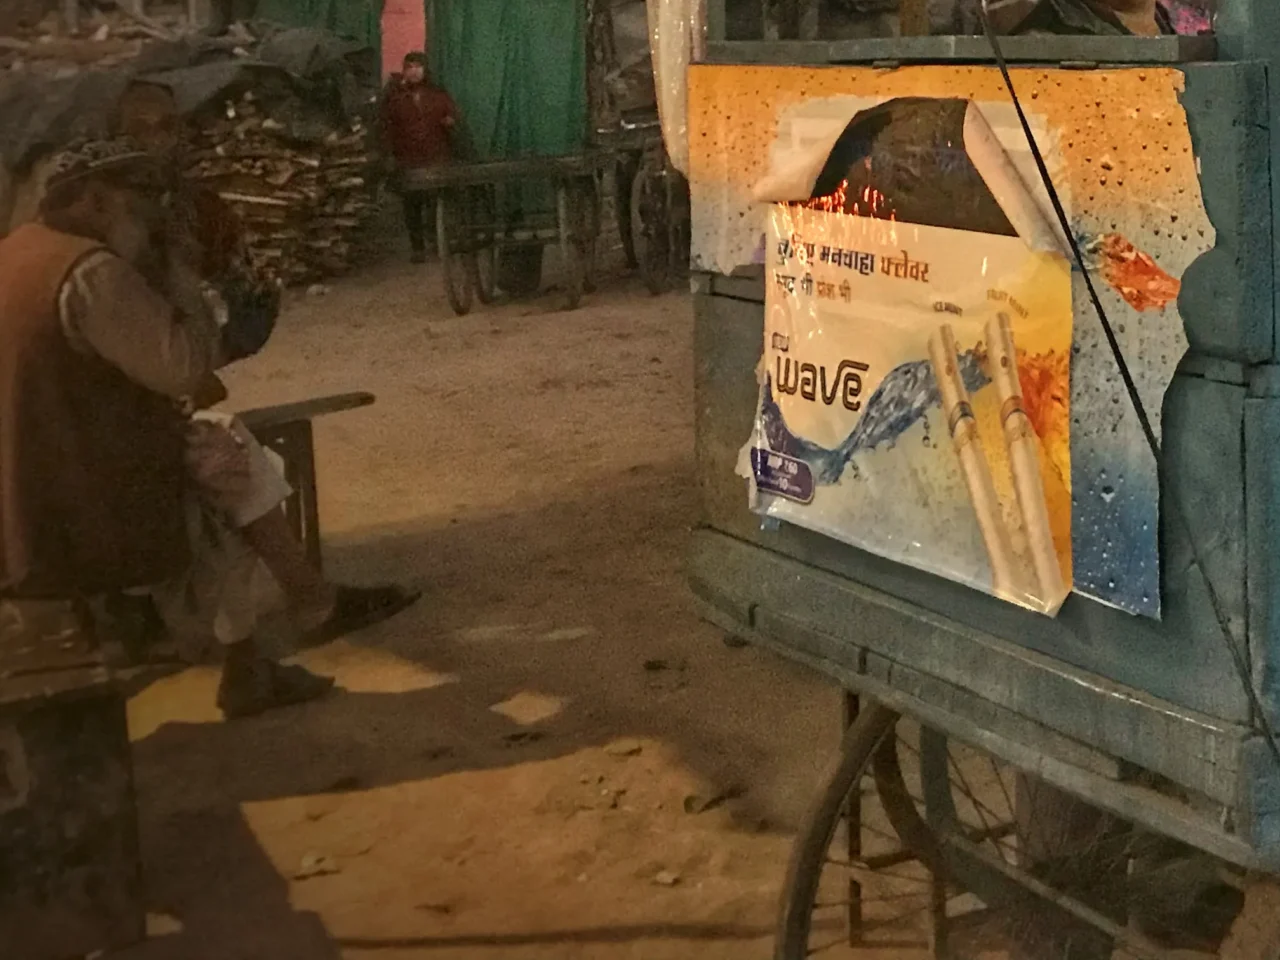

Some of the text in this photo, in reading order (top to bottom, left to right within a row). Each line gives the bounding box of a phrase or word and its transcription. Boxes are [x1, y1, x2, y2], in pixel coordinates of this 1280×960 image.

[819, 244, 876, 276] मनचाहा
[880, 250, 930, 283] फ्लेवर
[777, 355, 870, 412] wave
